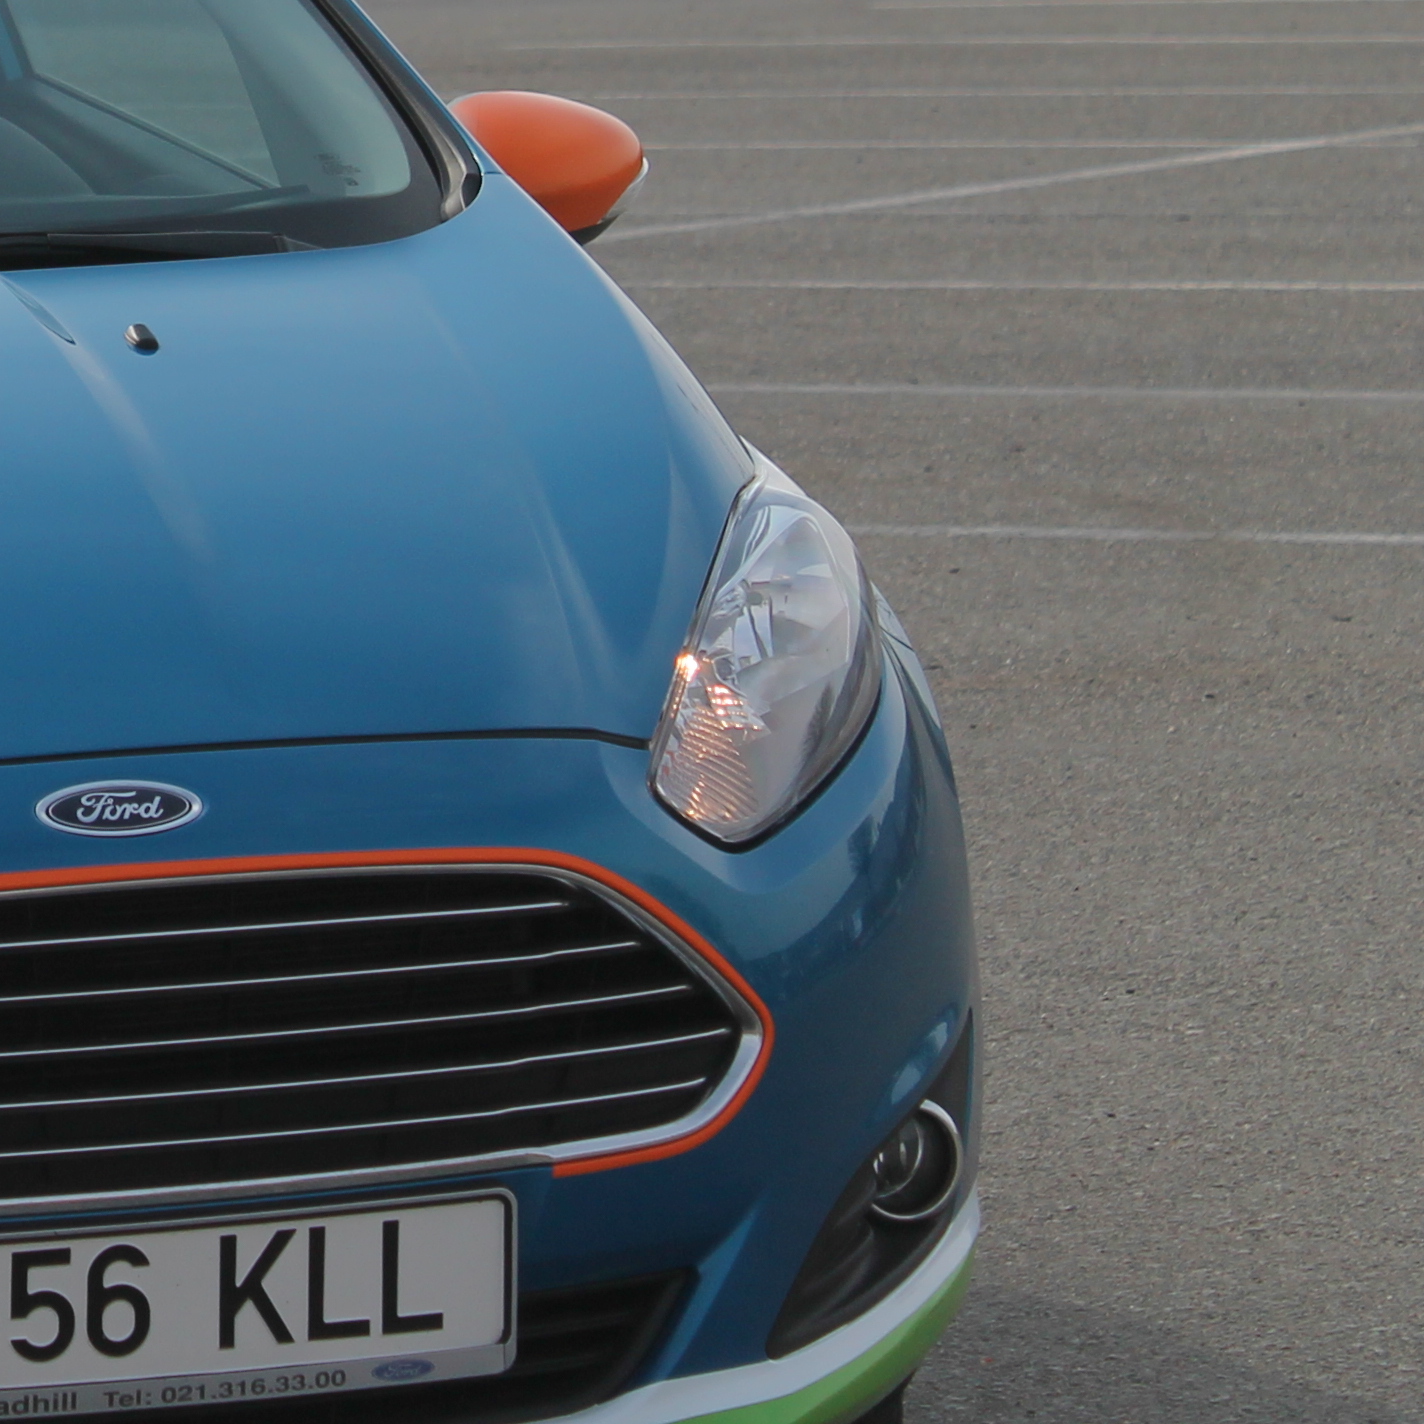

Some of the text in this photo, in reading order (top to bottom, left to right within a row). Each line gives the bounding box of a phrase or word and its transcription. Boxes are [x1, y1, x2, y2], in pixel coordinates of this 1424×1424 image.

[74, 788, 165, 825] Ford
[9, 1243, 151, 1362] 56
[217, 1219, 445, 1350] KLL
[103, 1384, 153, 1411] Tel:
[160, 1368, 349, 1406] 021.316.33.00
